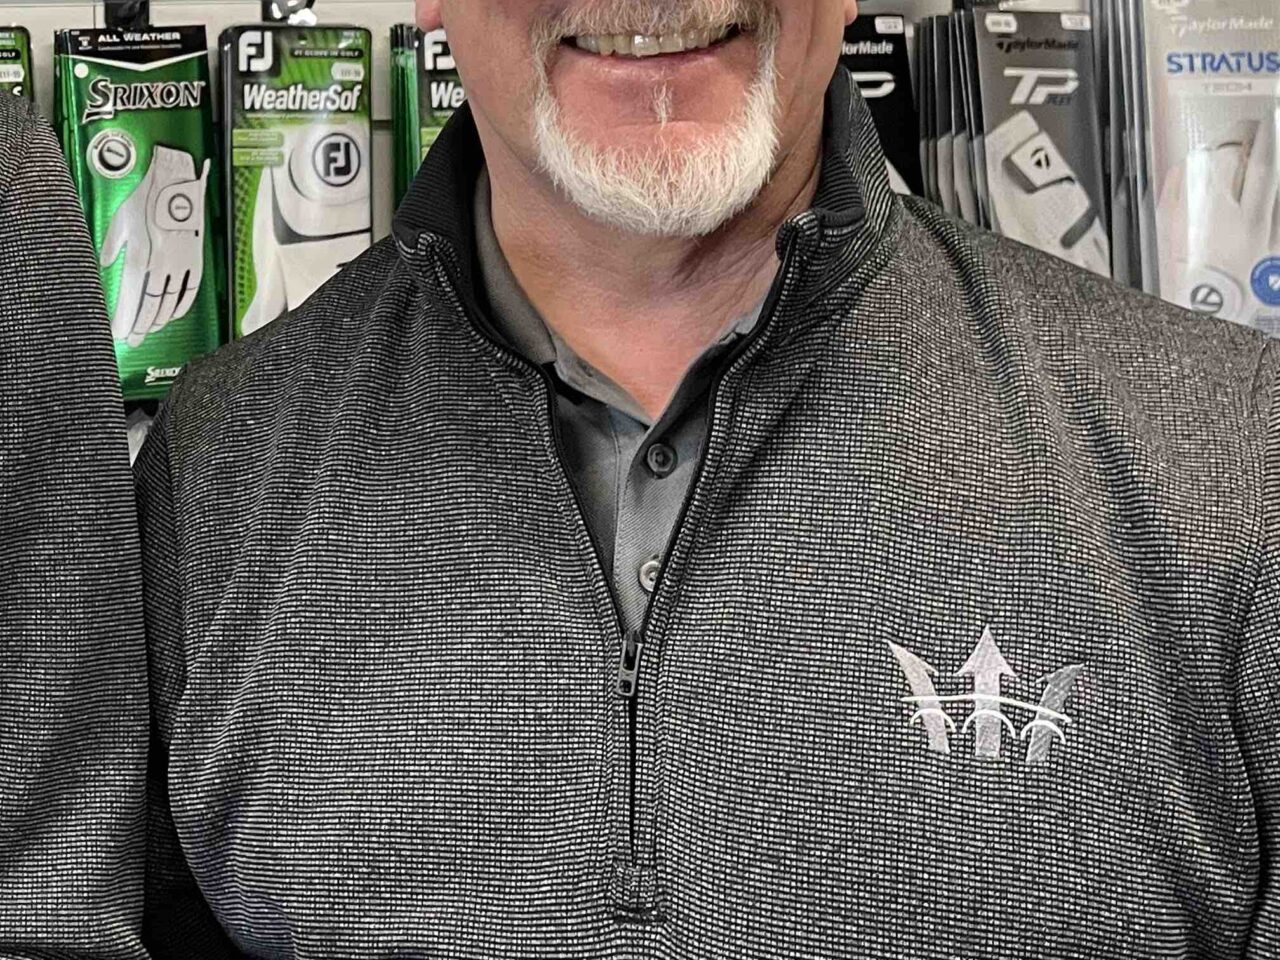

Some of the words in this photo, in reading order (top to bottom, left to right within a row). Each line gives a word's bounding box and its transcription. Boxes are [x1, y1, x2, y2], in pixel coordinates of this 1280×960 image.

[98, 34, 120, 43] ALL
[123, 31, 181, 42] WEATHER
[1170, 15, 1273, 38] TaylorMade
[239, 31, 273, 72] FJ
[1167, 51, 1280, 74] STRATUS
[82, 74, 206, 124] SRIXON
[243, 84, 362, 111] WeatherSof
[1004, 67, 1079, 105] TP
[323, 142, 352, 177] FJ
